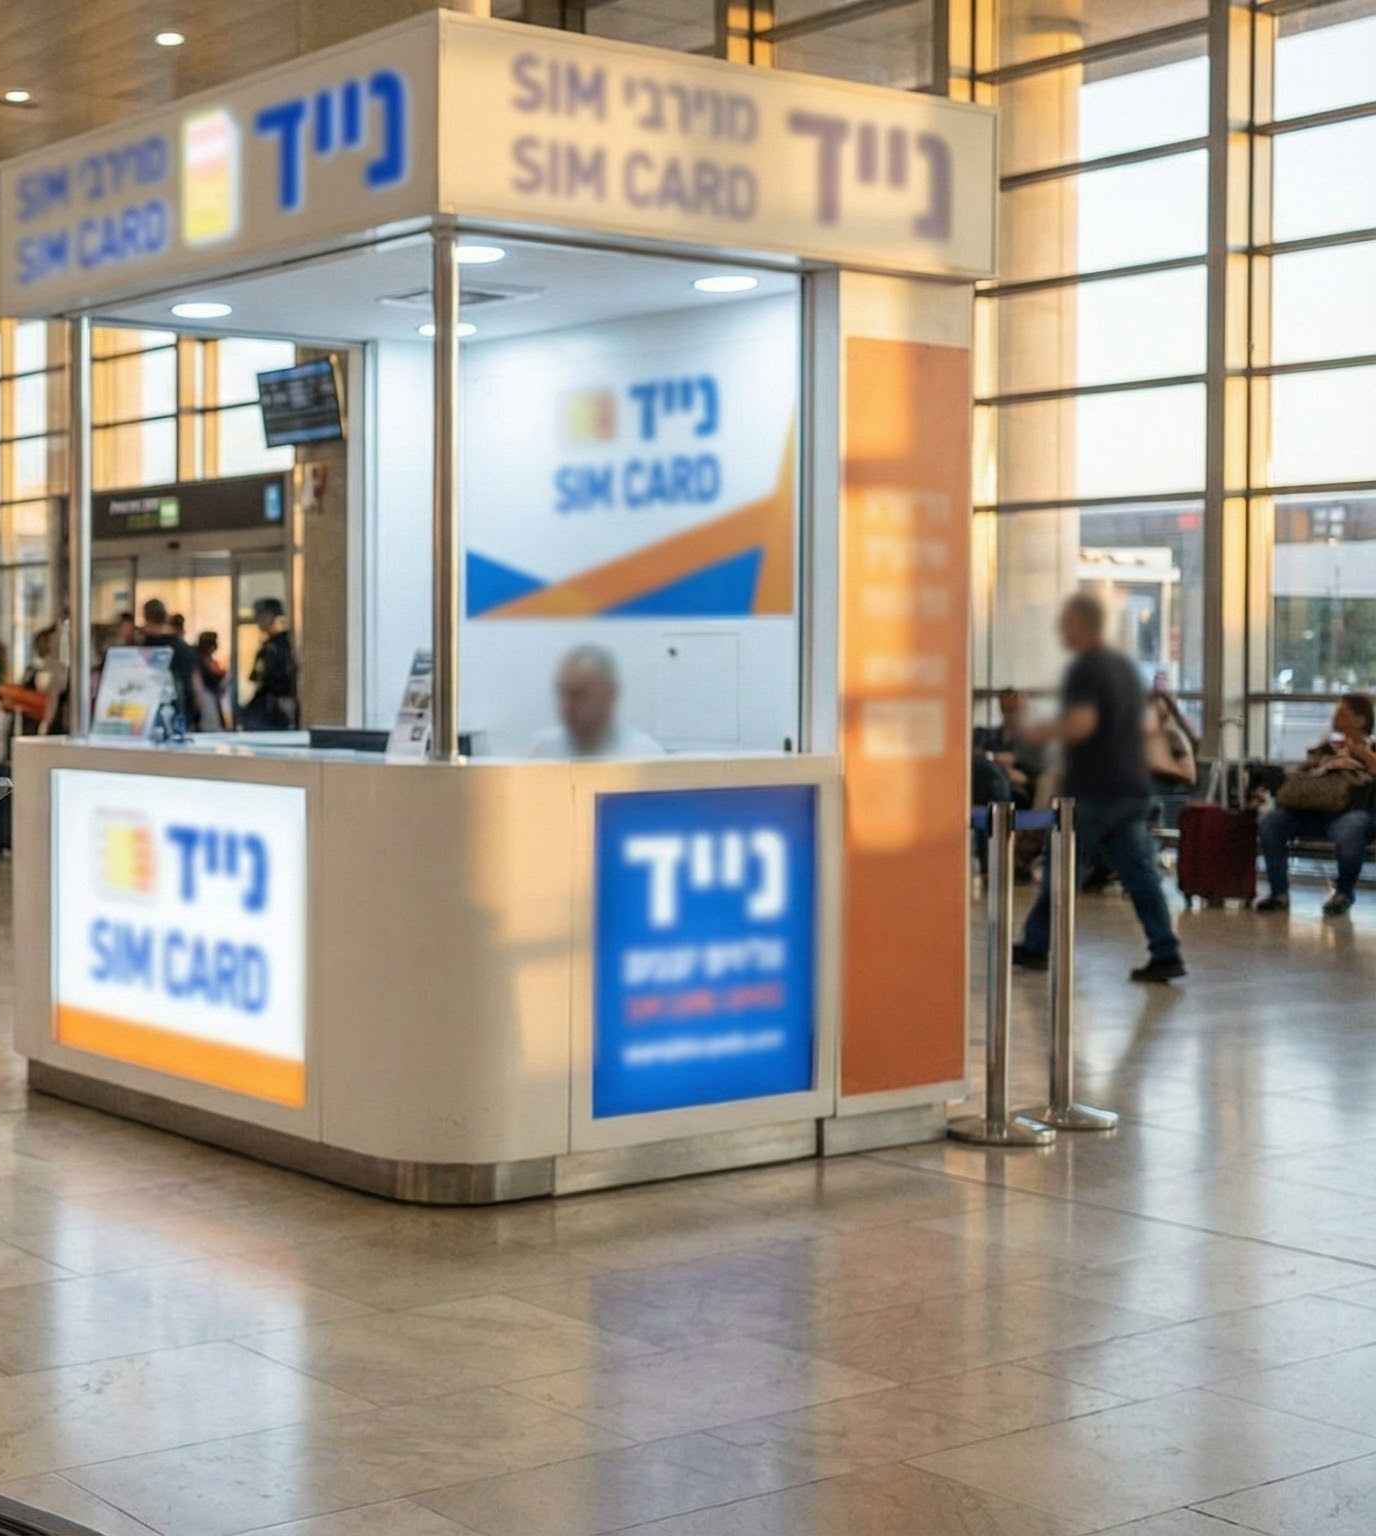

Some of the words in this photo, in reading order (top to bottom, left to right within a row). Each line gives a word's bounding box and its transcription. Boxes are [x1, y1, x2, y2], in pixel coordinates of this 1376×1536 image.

[511, 52, 607, 121] SIM
[254, 68, 408, 209] נייד
[511, 135, 607, 201] SIM
[623, 150, 759, 221] CARD
[788, 109, 954, 240] נייד
[77, 201, 167, 268] CARD
[629, 374, 719, 440] נייד
[624, 453, 722, 509] CARD
[166, 824, 269, 913] נייד
[623, 830, 788, 930] נייד
[89, 917, 152, 987] SIM
[163, 929, 270, 1014] CARD
